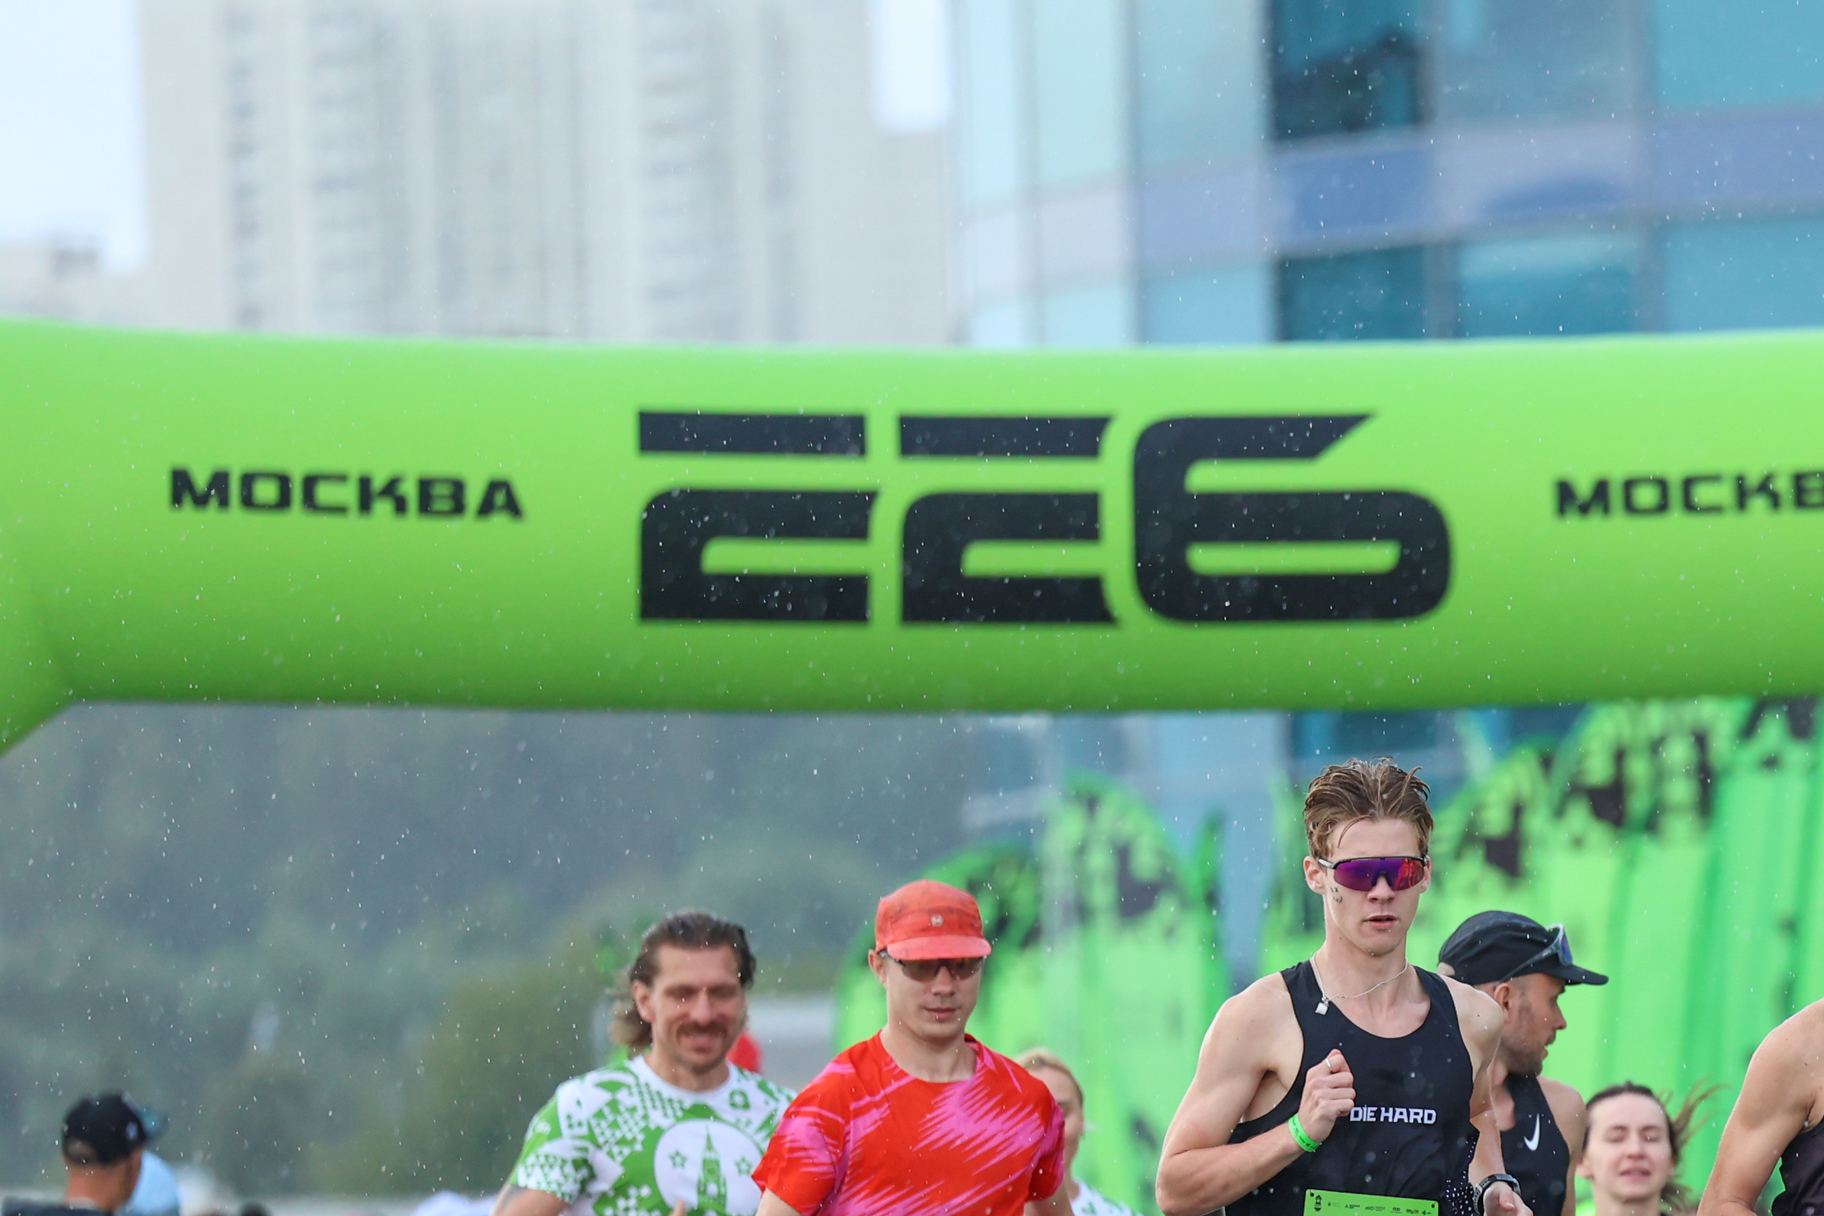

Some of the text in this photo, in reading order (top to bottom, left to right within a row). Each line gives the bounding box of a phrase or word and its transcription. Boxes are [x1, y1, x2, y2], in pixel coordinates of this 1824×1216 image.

[170, 467, 525, 521] МОСКВА
[1350, 1104, 1437, 1125] DIE HARD
